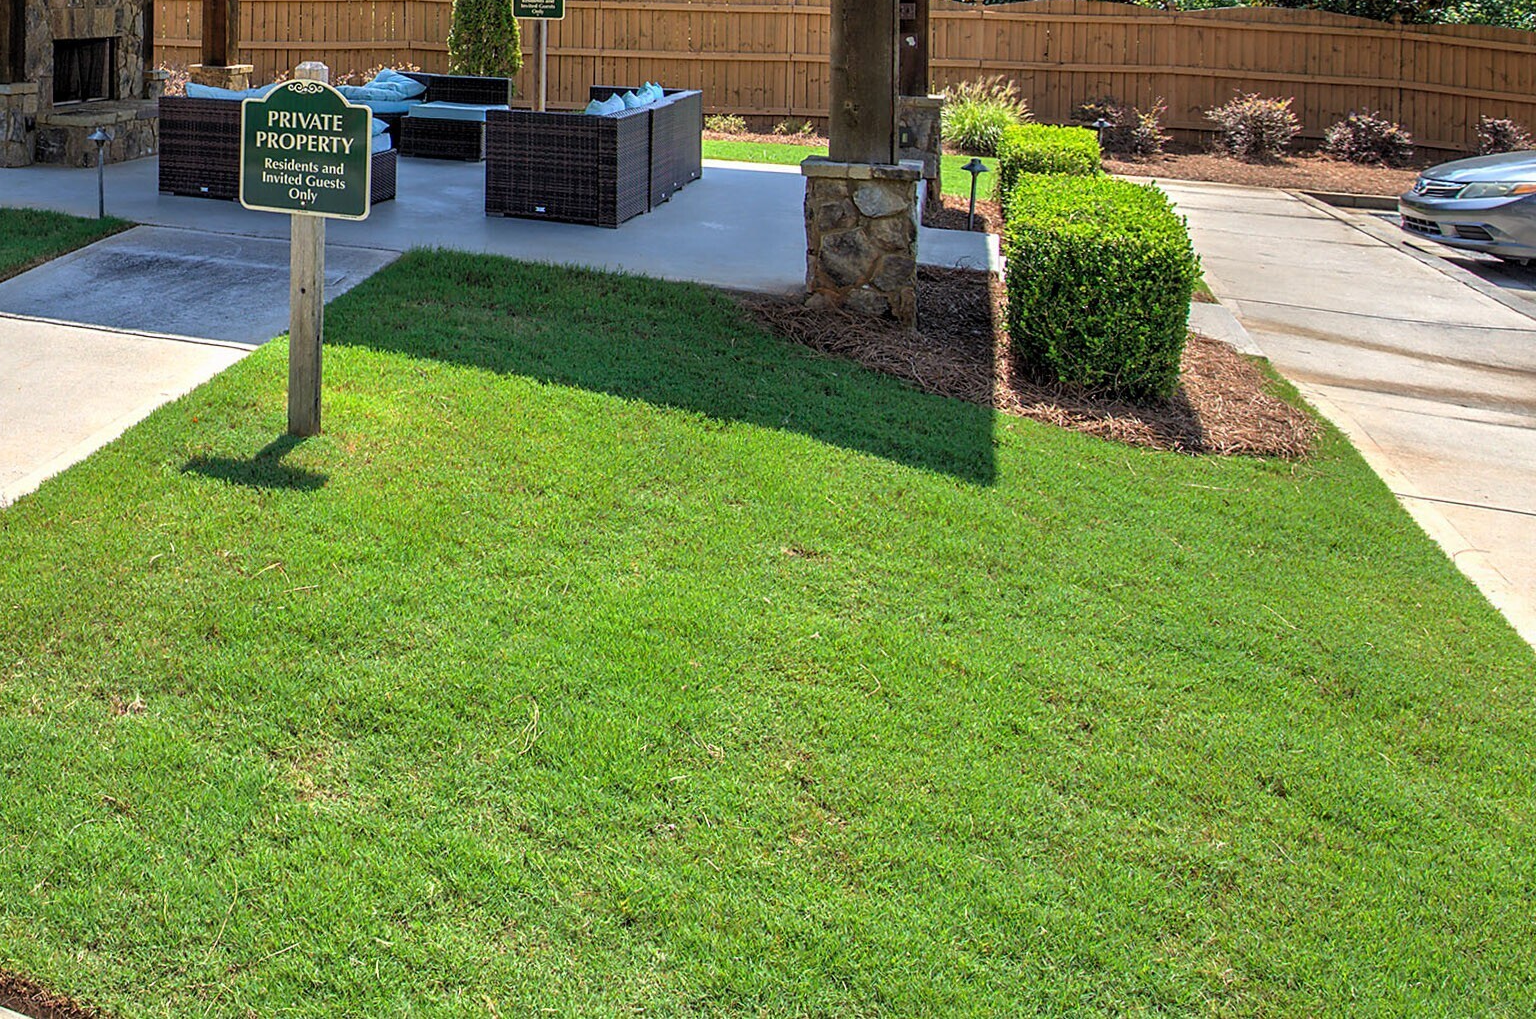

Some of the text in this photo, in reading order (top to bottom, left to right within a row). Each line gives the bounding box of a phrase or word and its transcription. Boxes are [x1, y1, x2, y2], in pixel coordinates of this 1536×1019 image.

[268, 111, 343, 131] PRIVATE
[256, 132, 354, 154] PROPERTY
[264, 157, 344, 175] Residents and
[262, 171, 346, 190] Invited Guests
[288, 187, 318, 204] Only
